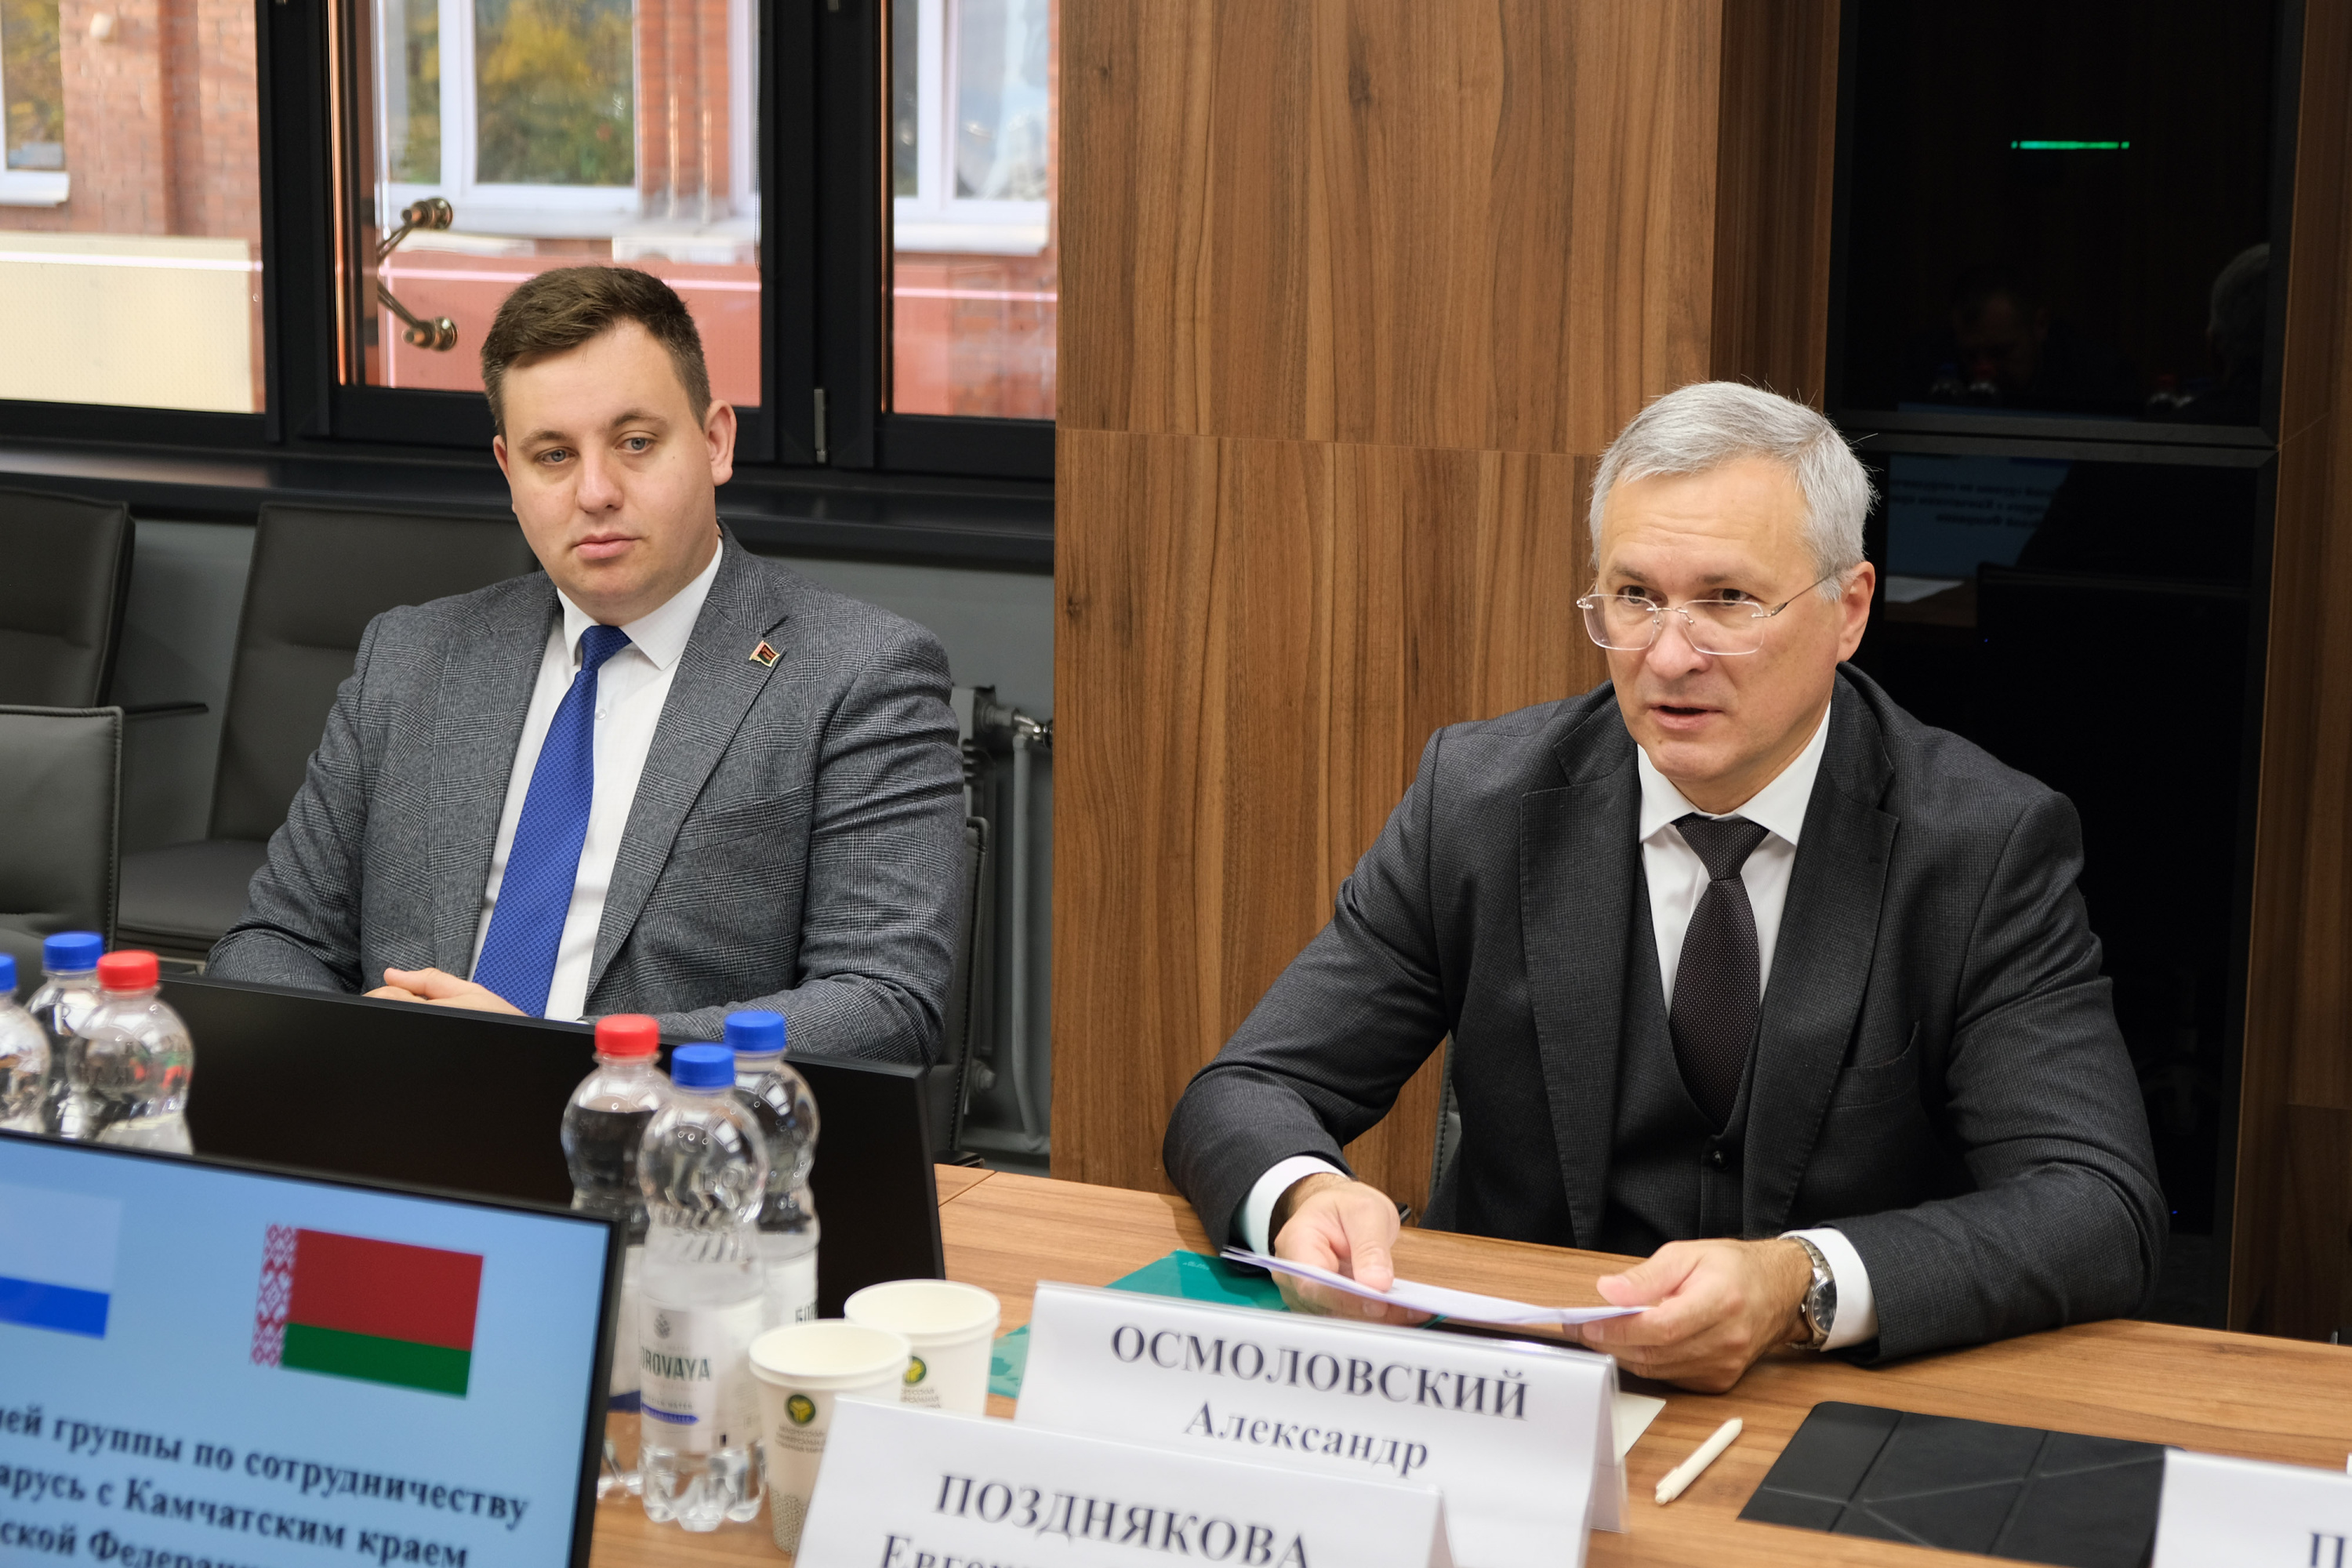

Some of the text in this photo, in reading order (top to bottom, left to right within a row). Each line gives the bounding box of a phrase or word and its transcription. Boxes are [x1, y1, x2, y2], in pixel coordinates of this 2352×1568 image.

[1111, 1325, 1530, 1421] ОСМОЛОВСКИЙ
[0, 1406, 529, 1531] ей группы по сотрудничеству
[1182, 1401, 1428, 1479] Александр
[96, 1481, 115, 1507] с
[123, 1477, 347, 1549] Камчатским
[357, 1530, 469, 1568] краем
[932, 1475, 1312, 1568] ПОЗДНЯКОВА
